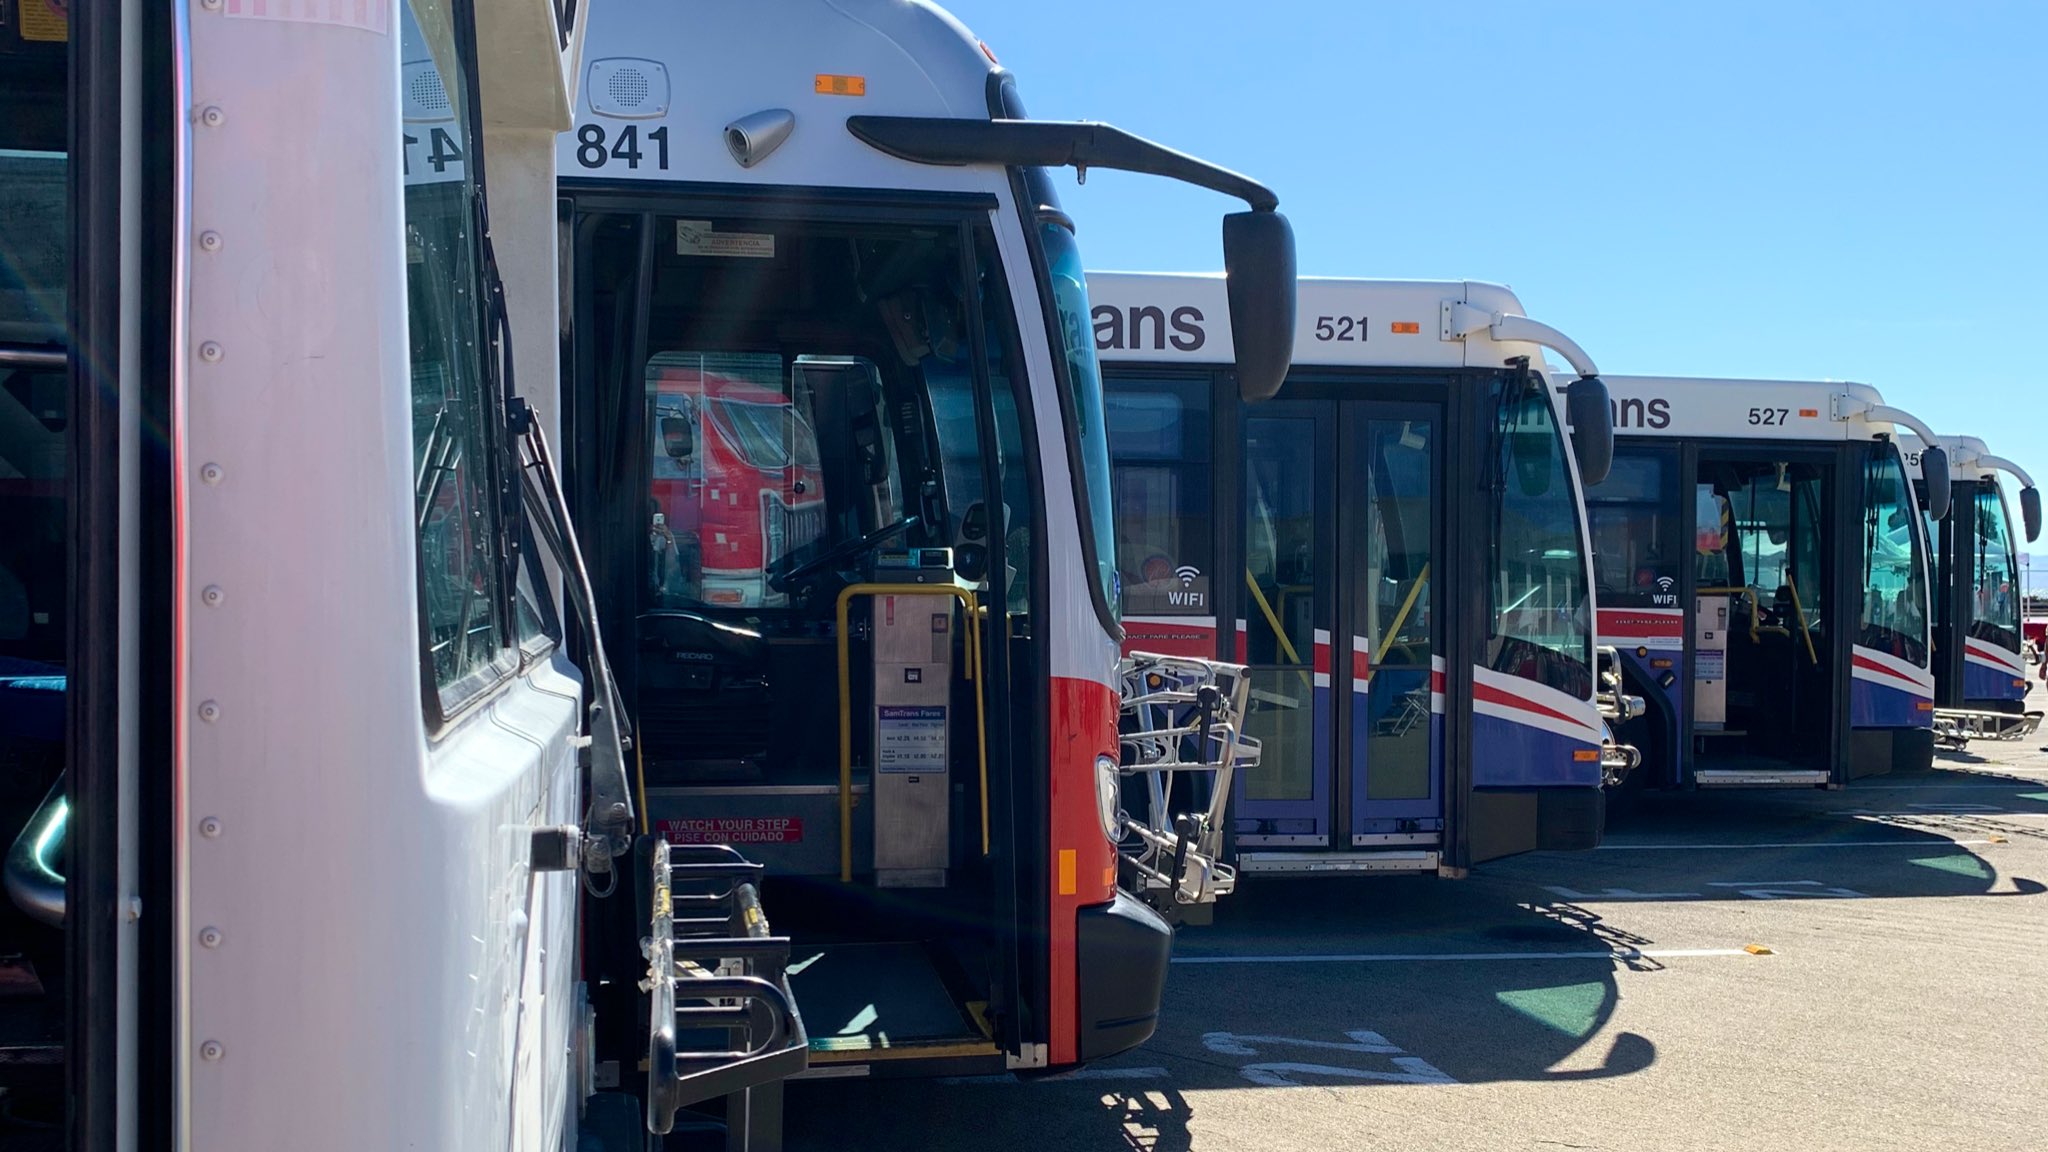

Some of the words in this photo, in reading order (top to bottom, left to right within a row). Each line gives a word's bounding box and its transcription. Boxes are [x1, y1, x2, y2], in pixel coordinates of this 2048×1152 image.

[576, 123, 669, 170] 841
[1315, 316, 1369, 342] 521
[1610, 397, 1671, 429] ns
[1748, 407, 1789, 426] 527
[1168, 591, 1204, 606] WIFI
[1653, 594, 1677, 604] WIFI
[668, 820, 714, 831] WATCH
[719, 820, 753, 830] YOUR
[757, 819, 790, 830] STEP
[675, 832, 700, 842] PISE
[704, 832, 729, 842] CON
[732, 831, 785, 842] CUIDADO
